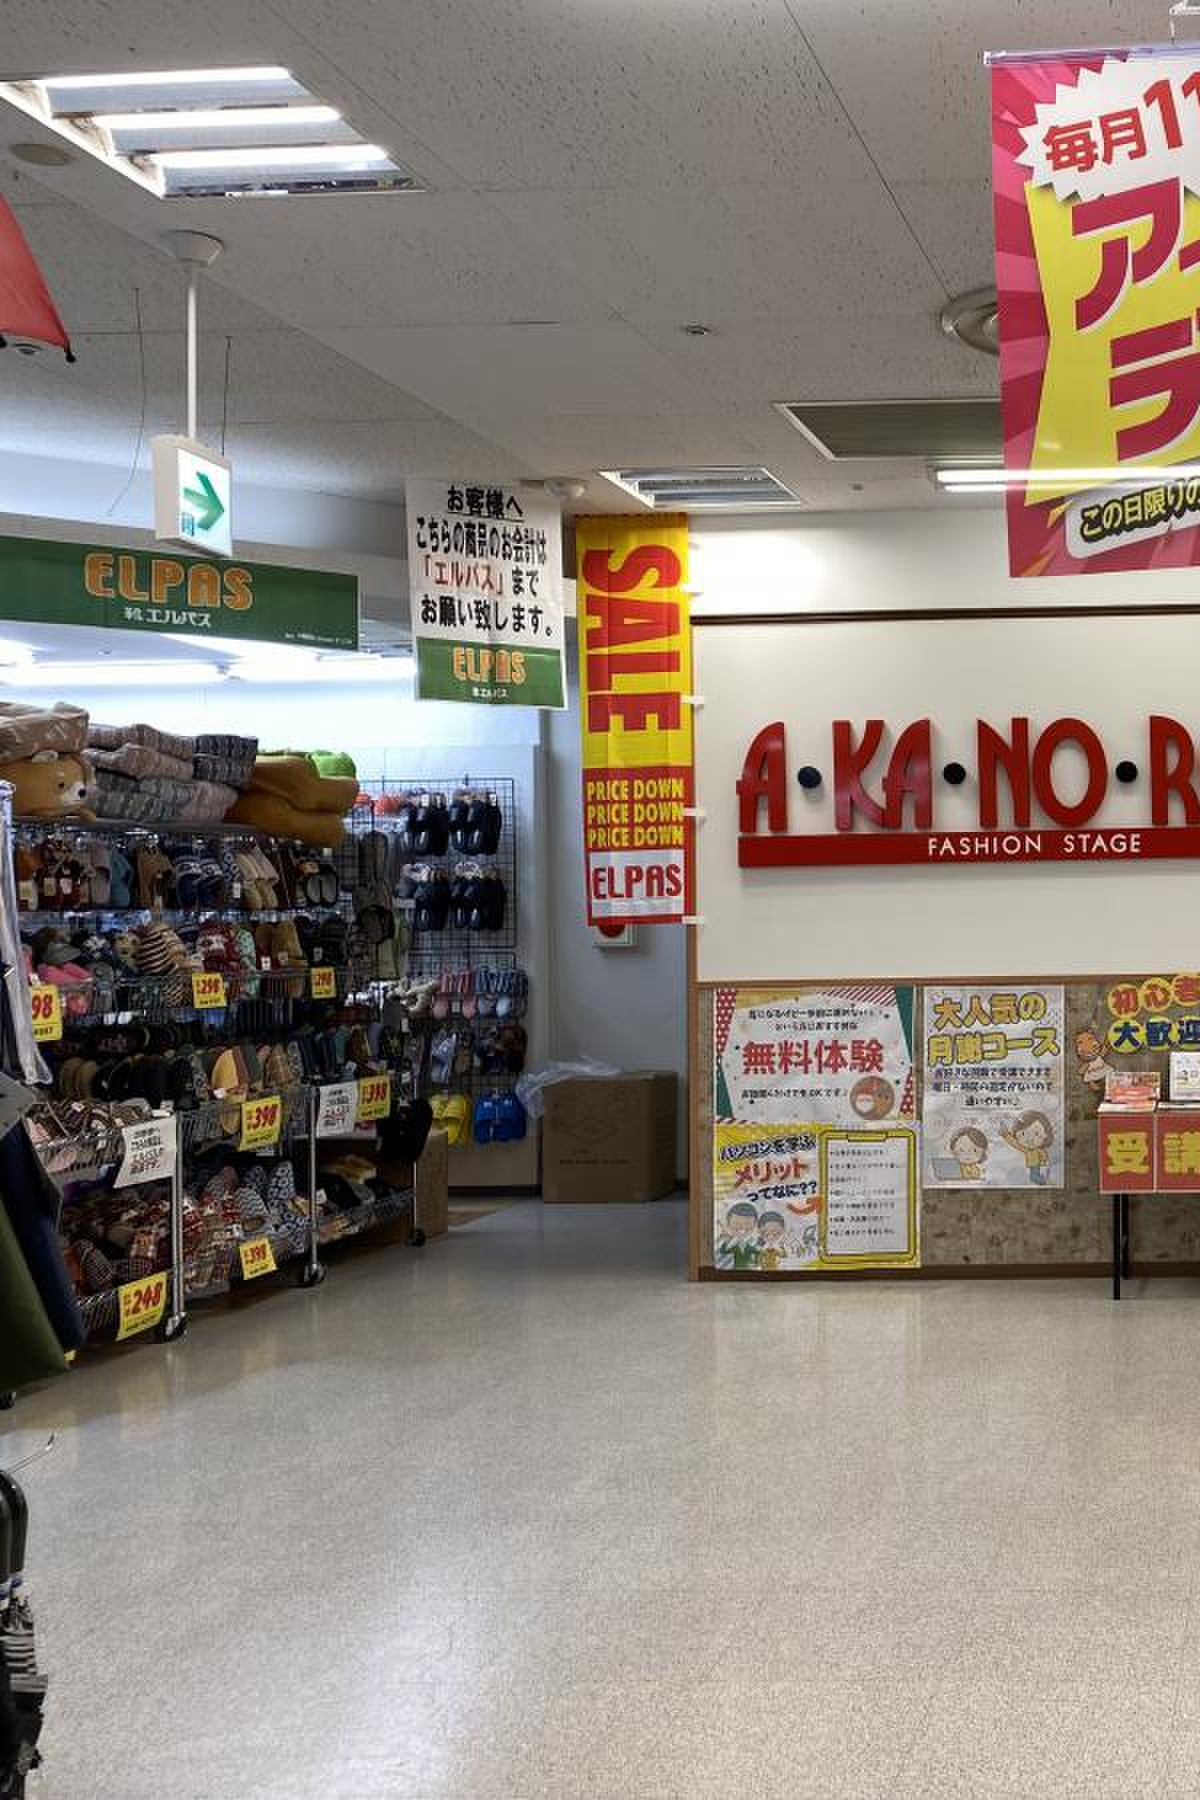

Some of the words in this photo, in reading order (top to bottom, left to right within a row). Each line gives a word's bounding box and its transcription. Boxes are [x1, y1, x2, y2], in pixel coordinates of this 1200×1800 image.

[447, 485, 523, 517] お客様へ
[416, 516, 547, 566] こちらの商品のお会計は
[84, 552, 254, 611] ELPAS
[420, 594, 553, 637] お願い致します。
[582, 544, 682, 733] SALE
[452, 647, 527, 685] ELPAS
[586, 778, 629, 800] PRICE
[633, 778, 684, 799] DOWN
[587, 802, 629, 824] PRICE
[633, 801, 684, 823] DOWN
[587, 826, 629, 848] PRICE
[634, 824, 684, 847] DOWN
[927, 833, 1042, 856] FASHION
[1063, 832, 1142, 855] STAGE
[591, 864, 683, 900] ELPAS
[32, 993, 54, 1020] 98
[933, 992, 1047, 1030] 大人気の
[742, 1038, 884, 1075] 無料体験
[928, 1027, 1060, 1066] 月謝コース
[735, 1157, 808, 1185] メリット
